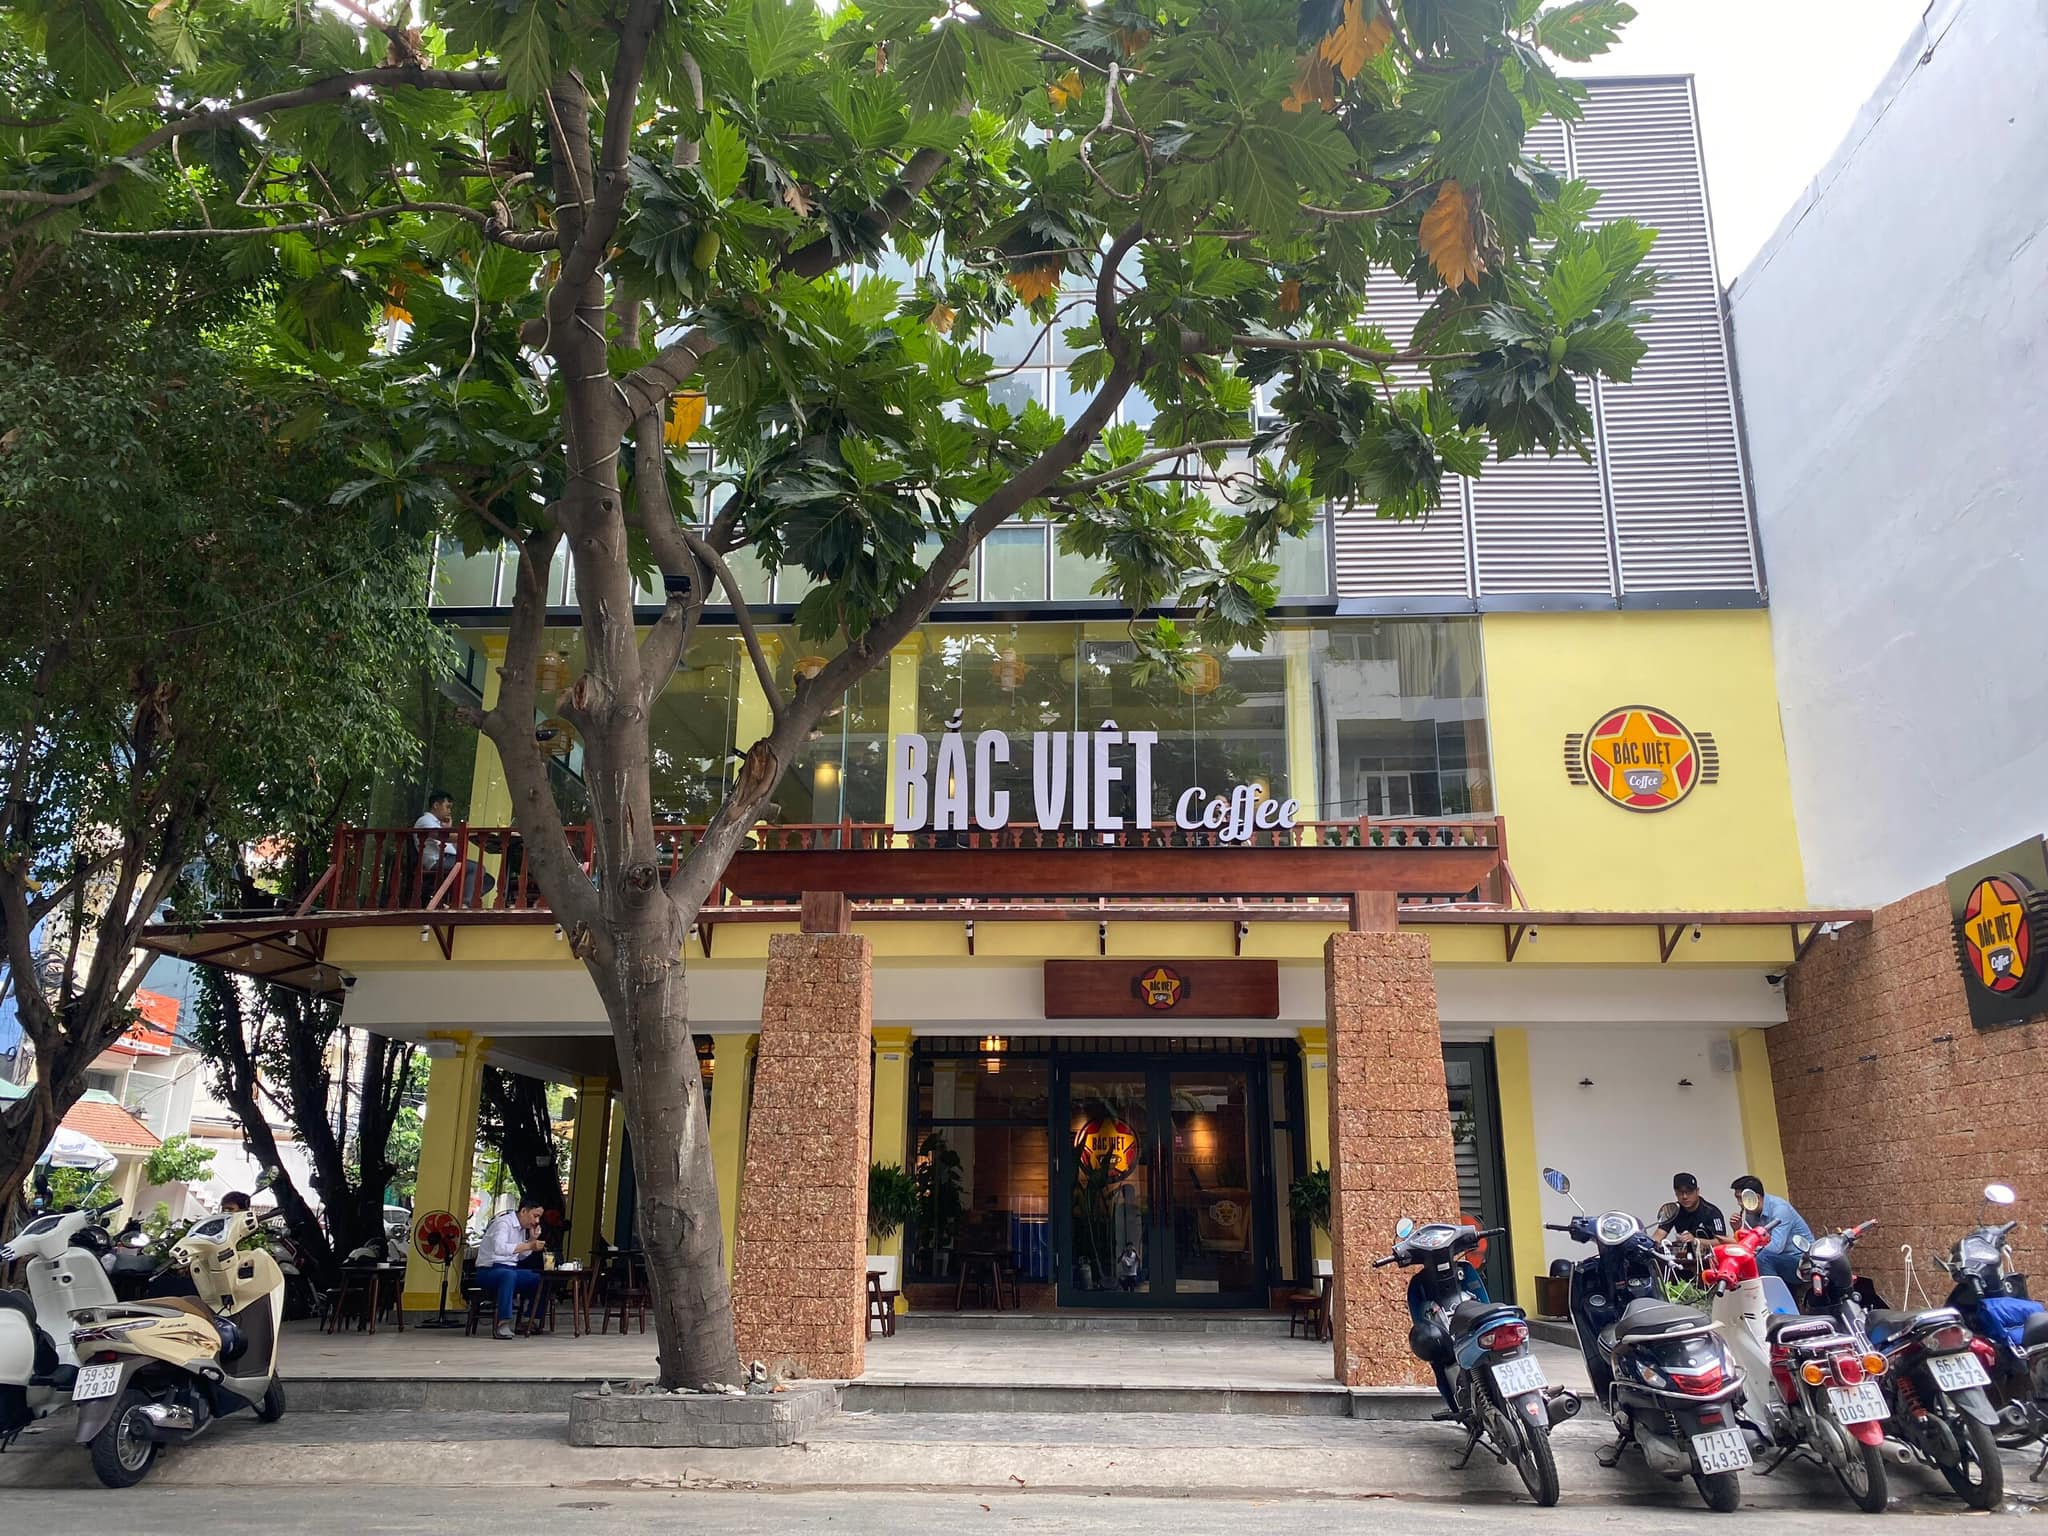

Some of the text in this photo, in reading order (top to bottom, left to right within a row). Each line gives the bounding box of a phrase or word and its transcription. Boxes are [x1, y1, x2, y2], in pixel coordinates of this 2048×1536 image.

[893, 708, 1299, 844] BẮC VIỆT Coffee
[1629, 775, 1658, 789] Coffee
[1702, 1449, 1748, 1471] 549.35
